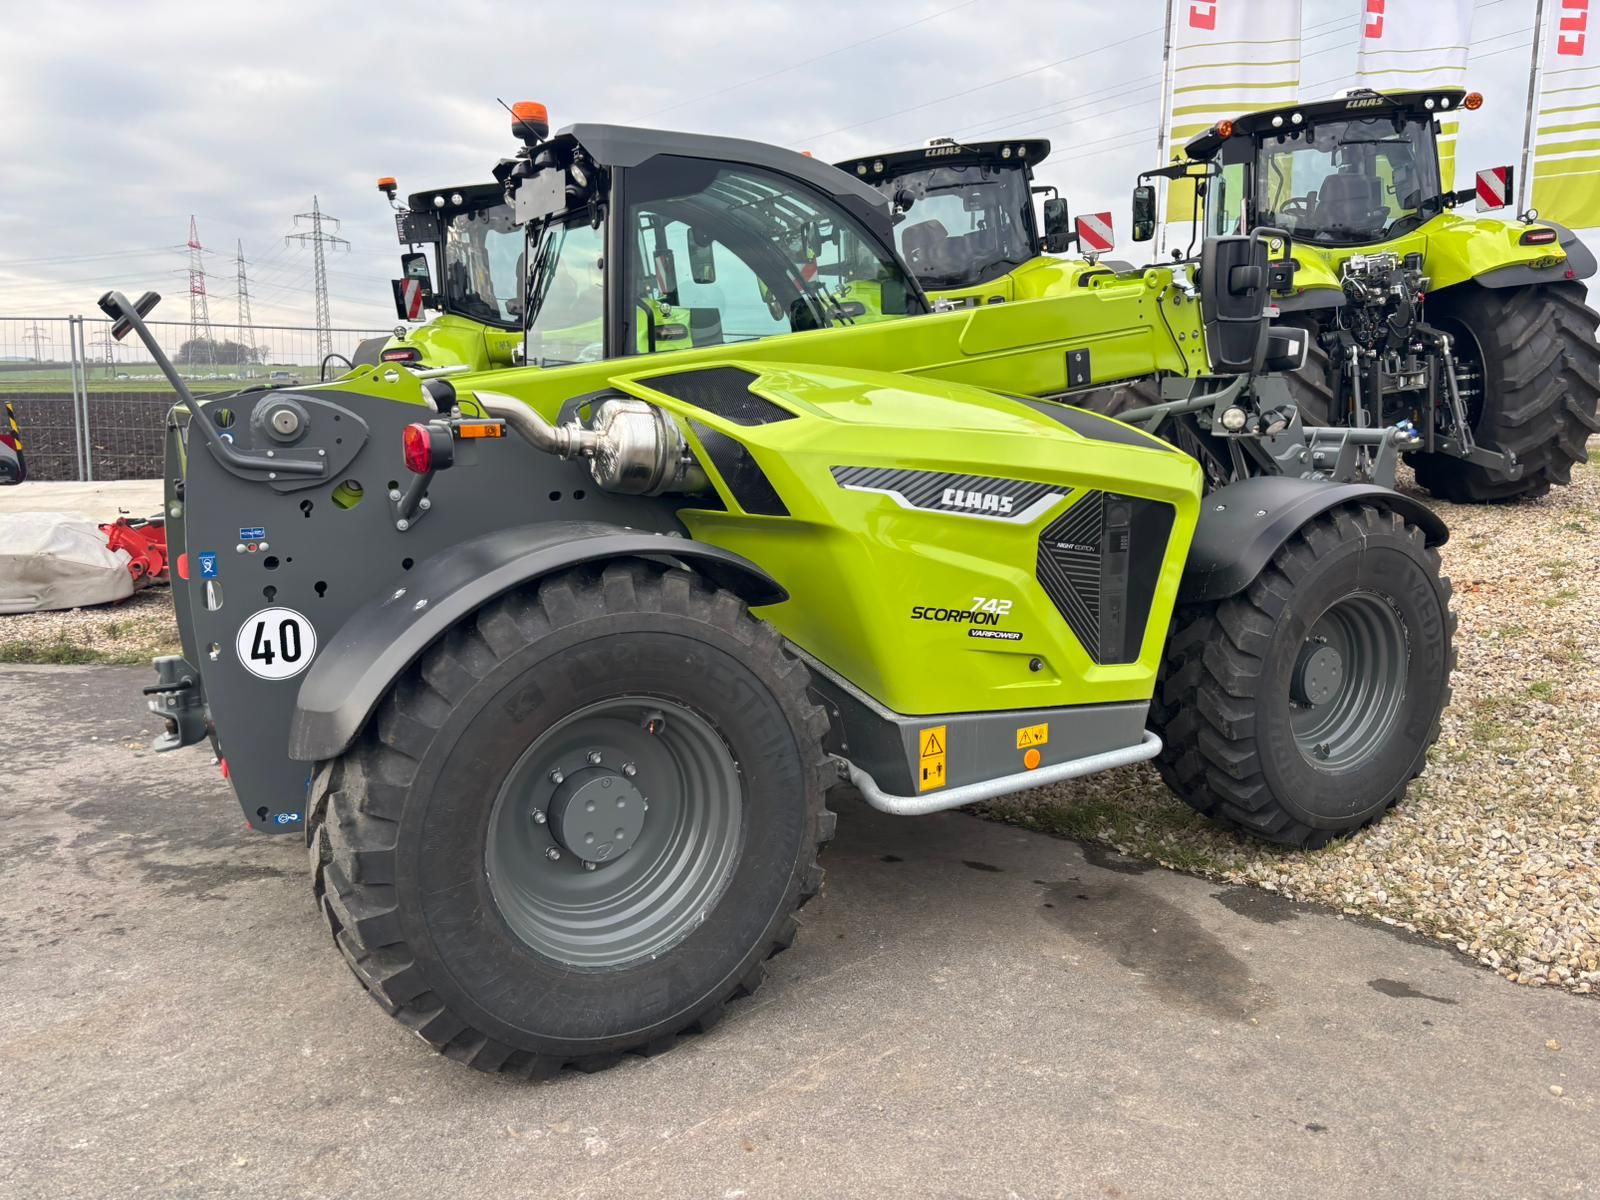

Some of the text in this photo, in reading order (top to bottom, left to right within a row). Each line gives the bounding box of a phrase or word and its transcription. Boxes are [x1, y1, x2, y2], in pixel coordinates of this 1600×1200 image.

[1345, 97, 1385, 109] CLAAS
[925, 146, 961, 157] CLAAS
[941, 488, 1014, 513] CLAAS
[1074, 544, 1096, 552] EDITION
[970, 596, 1013, 615] 742
[911, 606, 1000, 626] SCORPION
[251, 618, 302, 665] 40
[970, 629, 1020, 639] VARIPOWER
